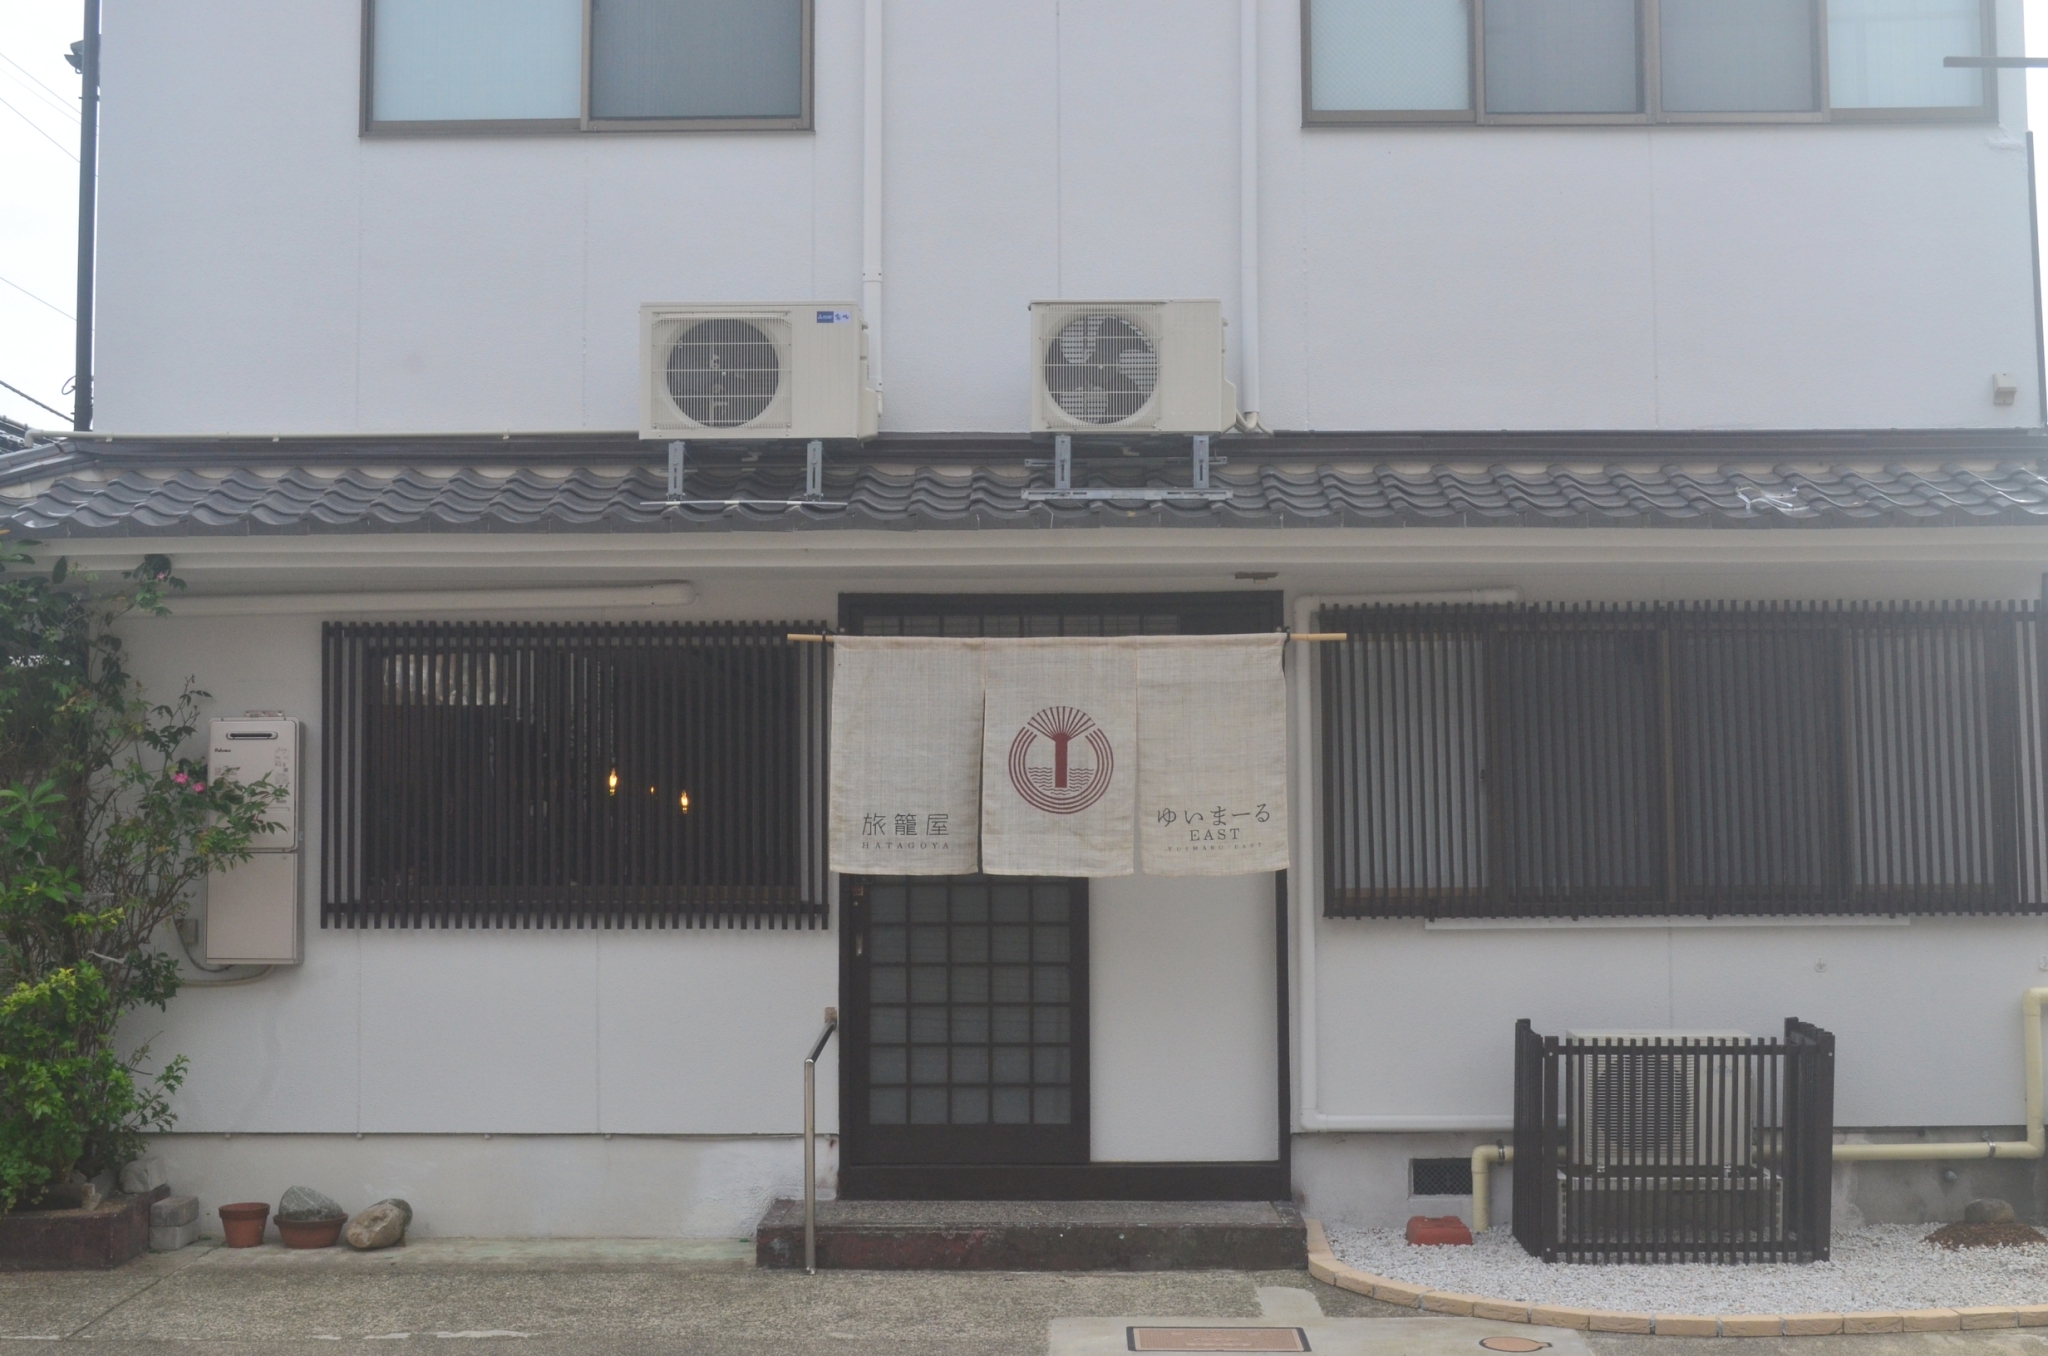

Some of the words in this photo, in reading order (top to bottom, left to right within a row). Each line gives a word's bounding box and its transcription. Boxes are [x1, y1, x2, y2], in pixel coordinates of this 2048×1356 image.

[862, 812, 949, 836] 旅籠屋
[1157, 803, 1270, 828] ゆいまーる
[1189, 828, 1240, 841] EAST
[1234, 842, 1262, 850] EAST
